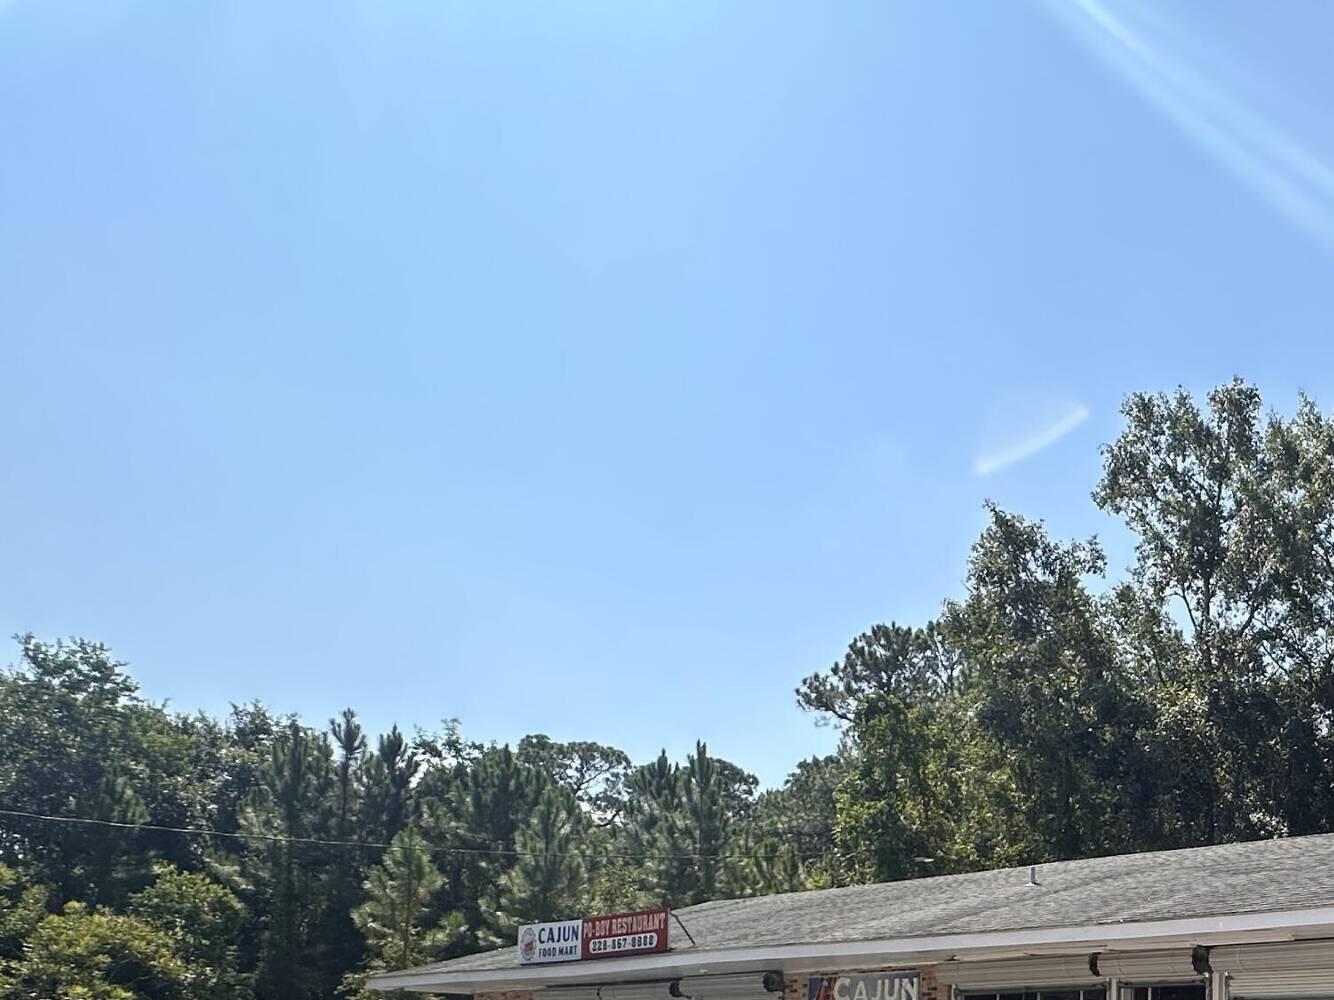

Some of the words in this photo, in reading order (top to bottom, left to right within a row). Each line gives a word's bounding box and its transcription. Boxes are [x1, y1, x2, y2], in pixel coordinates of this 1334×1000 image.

[538, 925, 580, 944] CAJUN
[583, 919, 610, 938] PO-BOY
[611, 912, 666, 934] RESTAURANT
[538, 947, 557, 958] FOOD
[558, 945, 577, 956] MART
